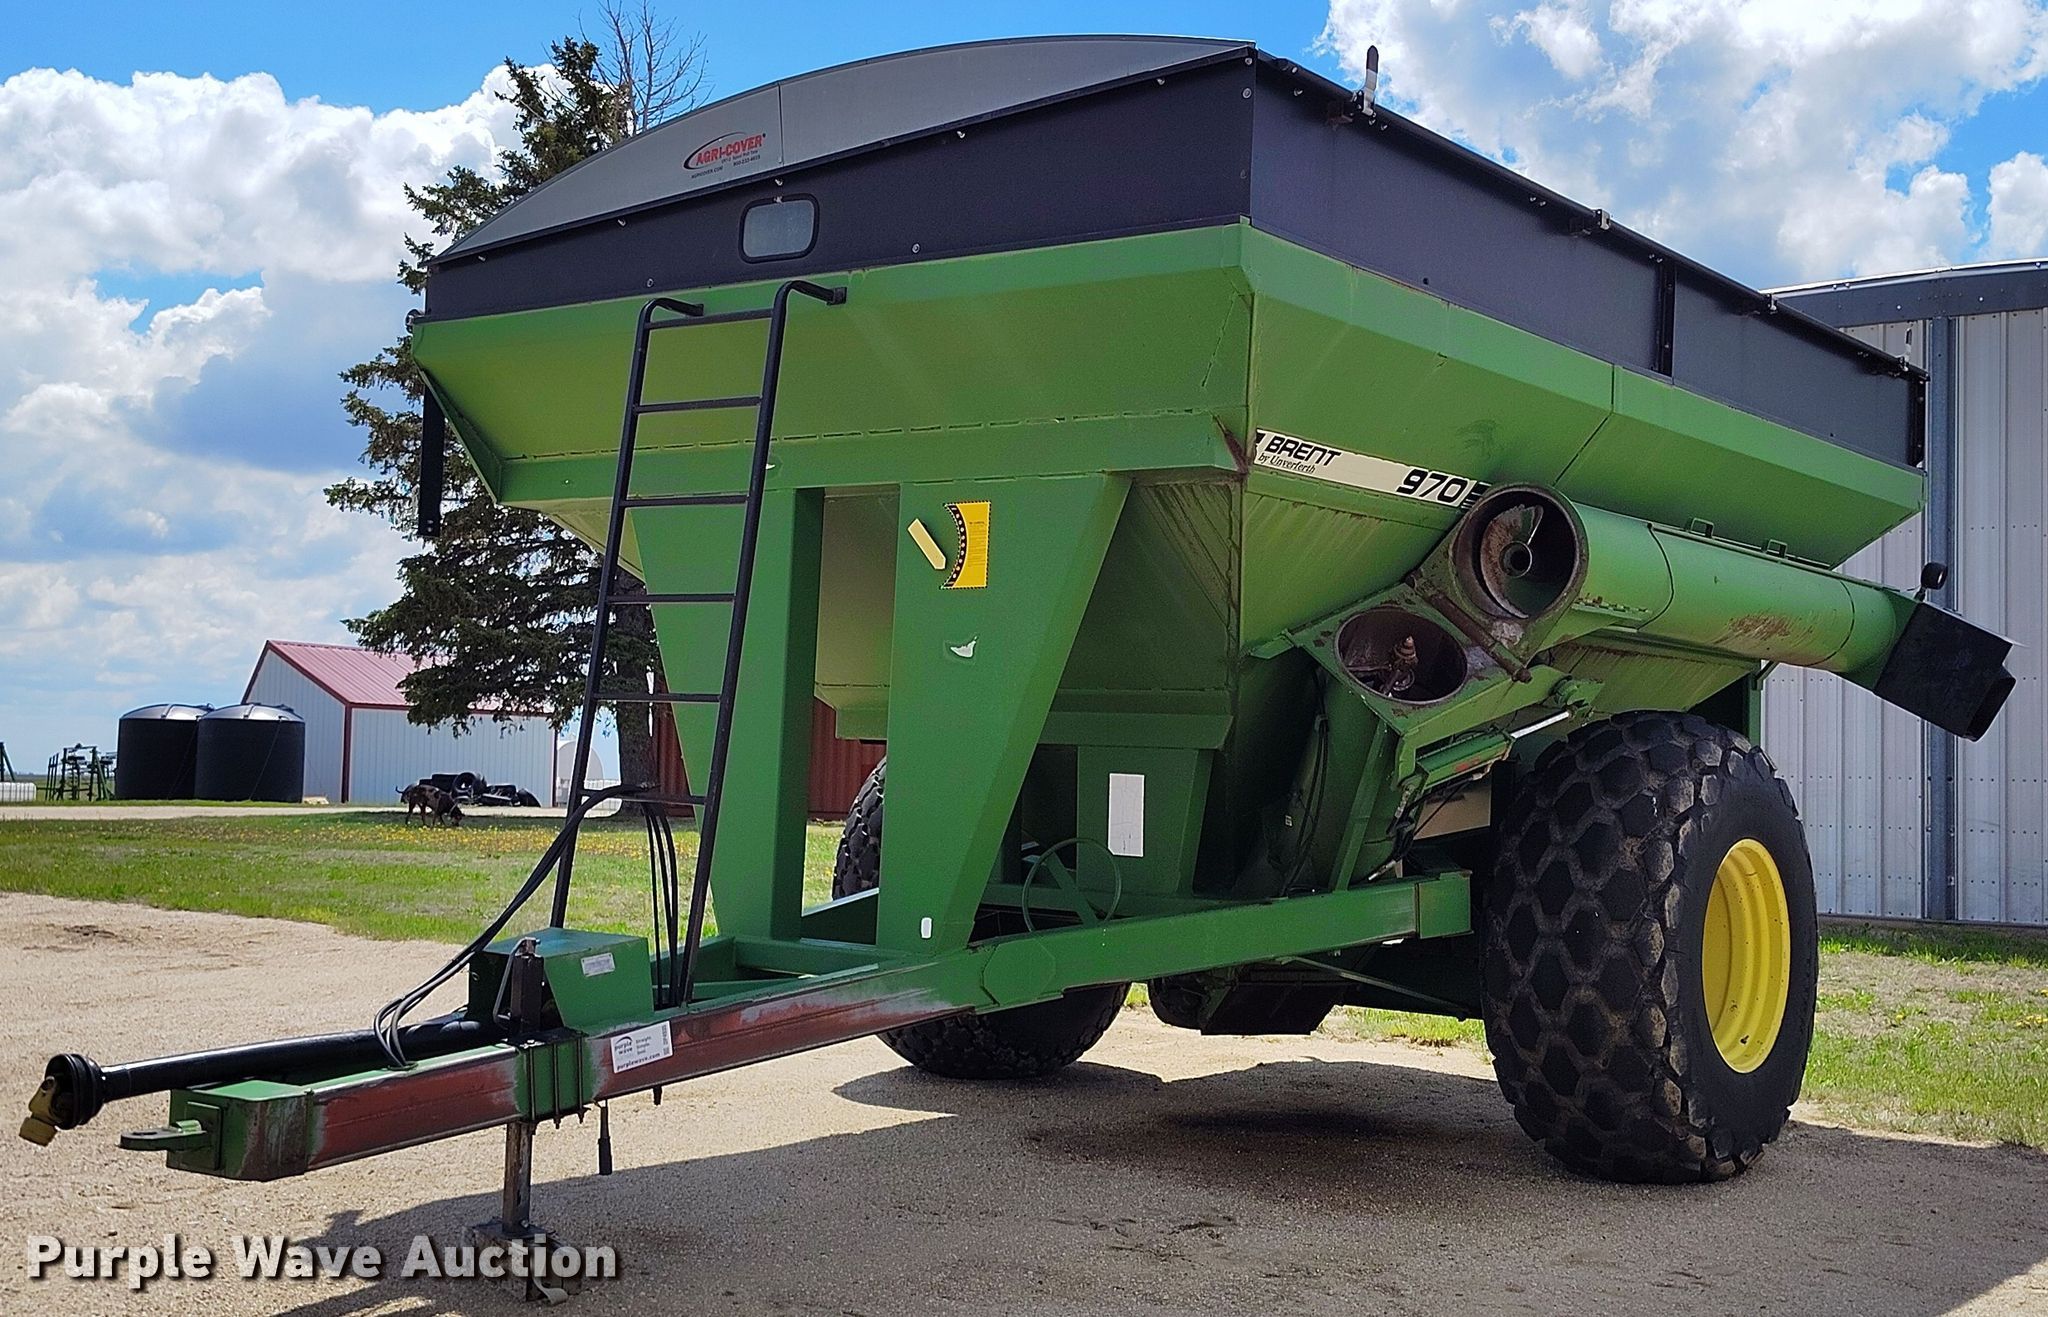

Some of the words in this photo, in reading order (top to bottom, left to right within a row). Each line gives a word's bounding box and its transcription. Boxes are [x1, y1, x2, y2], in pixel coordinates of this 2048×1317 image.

[1258, 453, 1270, 464] by
[1270, 454, 1316, 474] Unverferth
[1265, 435, 1342, 466] BRENT
[1397, 468, 1467, 501] 970
[617, 1053, 660, 1070] purplewave.com
